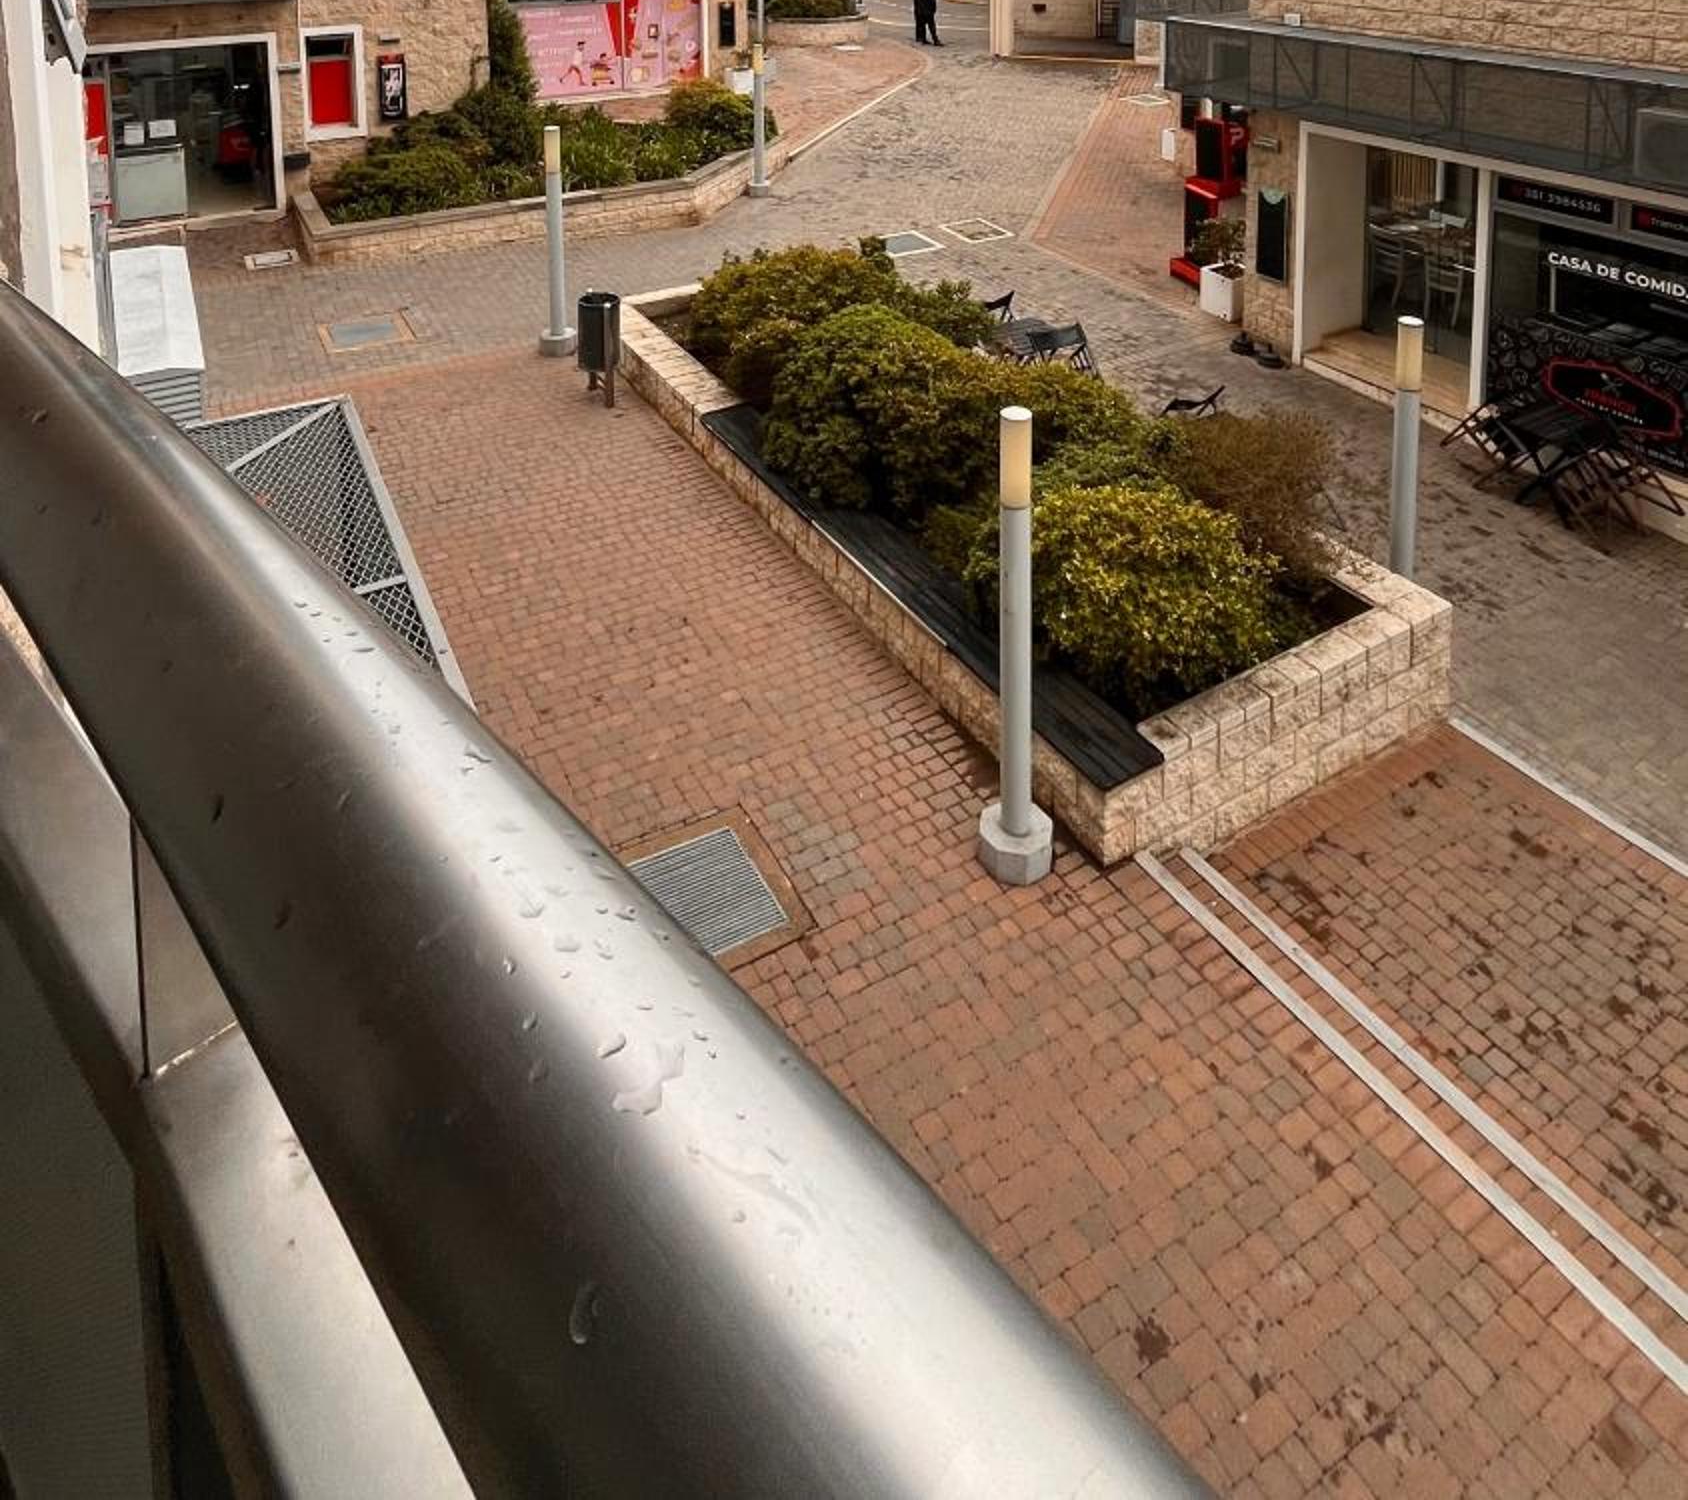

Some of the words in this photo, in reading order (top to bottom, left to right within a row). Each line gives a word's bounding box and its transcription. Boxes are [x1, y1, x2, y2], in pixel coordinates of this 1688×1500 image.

[1548, 251, 1593, 273] CASA
[1597, 263, 1620, 280] DE
[1625, 271, 1688, 299] COMID
